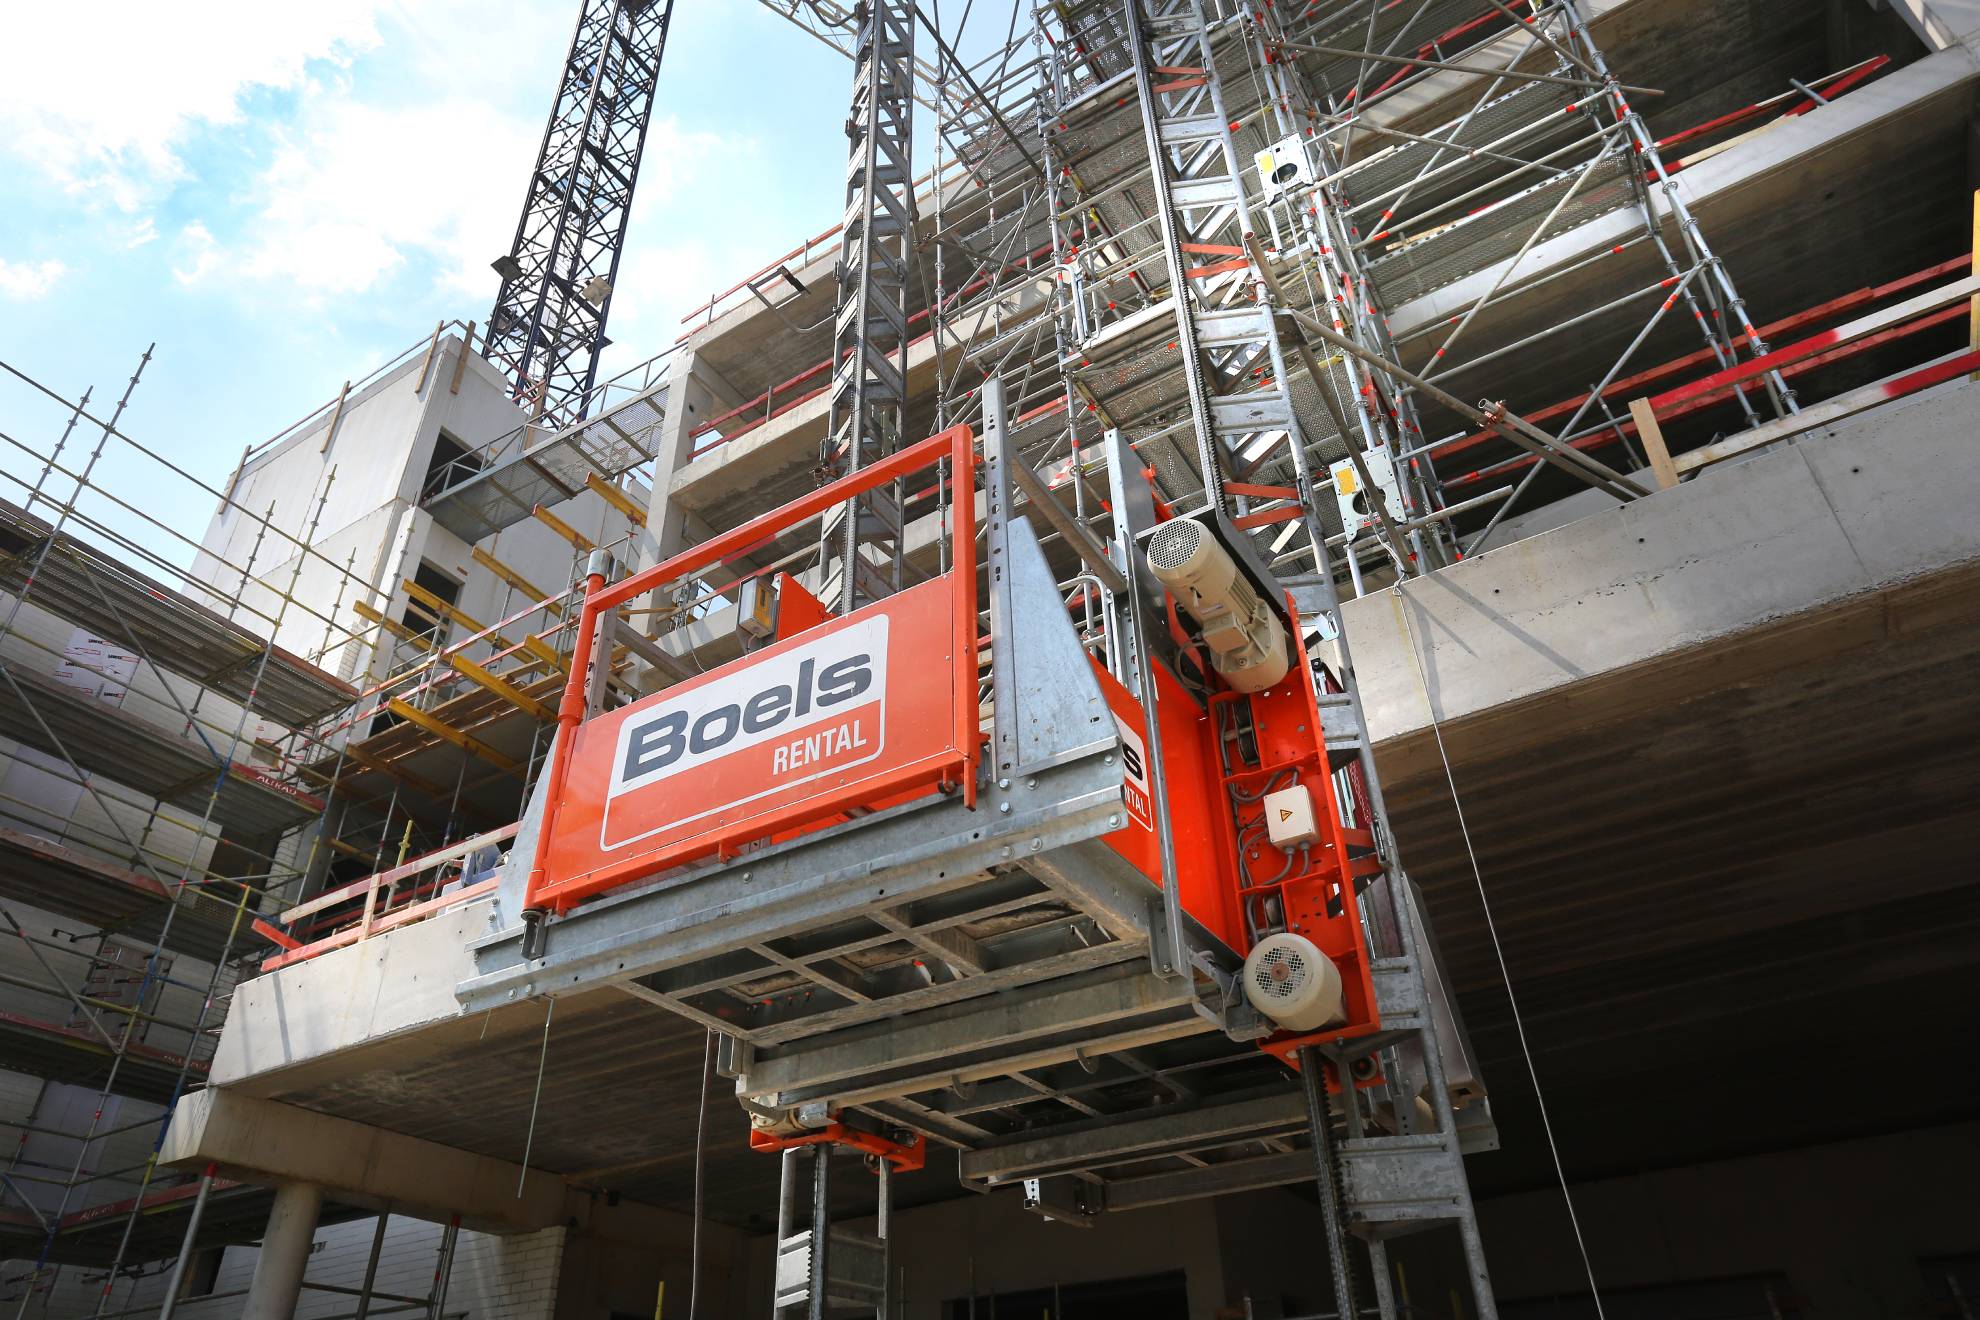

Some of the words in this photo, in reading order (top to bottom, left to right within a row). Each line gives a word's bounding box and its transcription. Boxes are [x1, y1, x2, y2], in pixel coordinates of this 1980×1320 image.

[622, 654, 873, 783] Boels
[772, 720, 867, 776] RENTAL
[1124, 784, 1147, 818] NTAL
